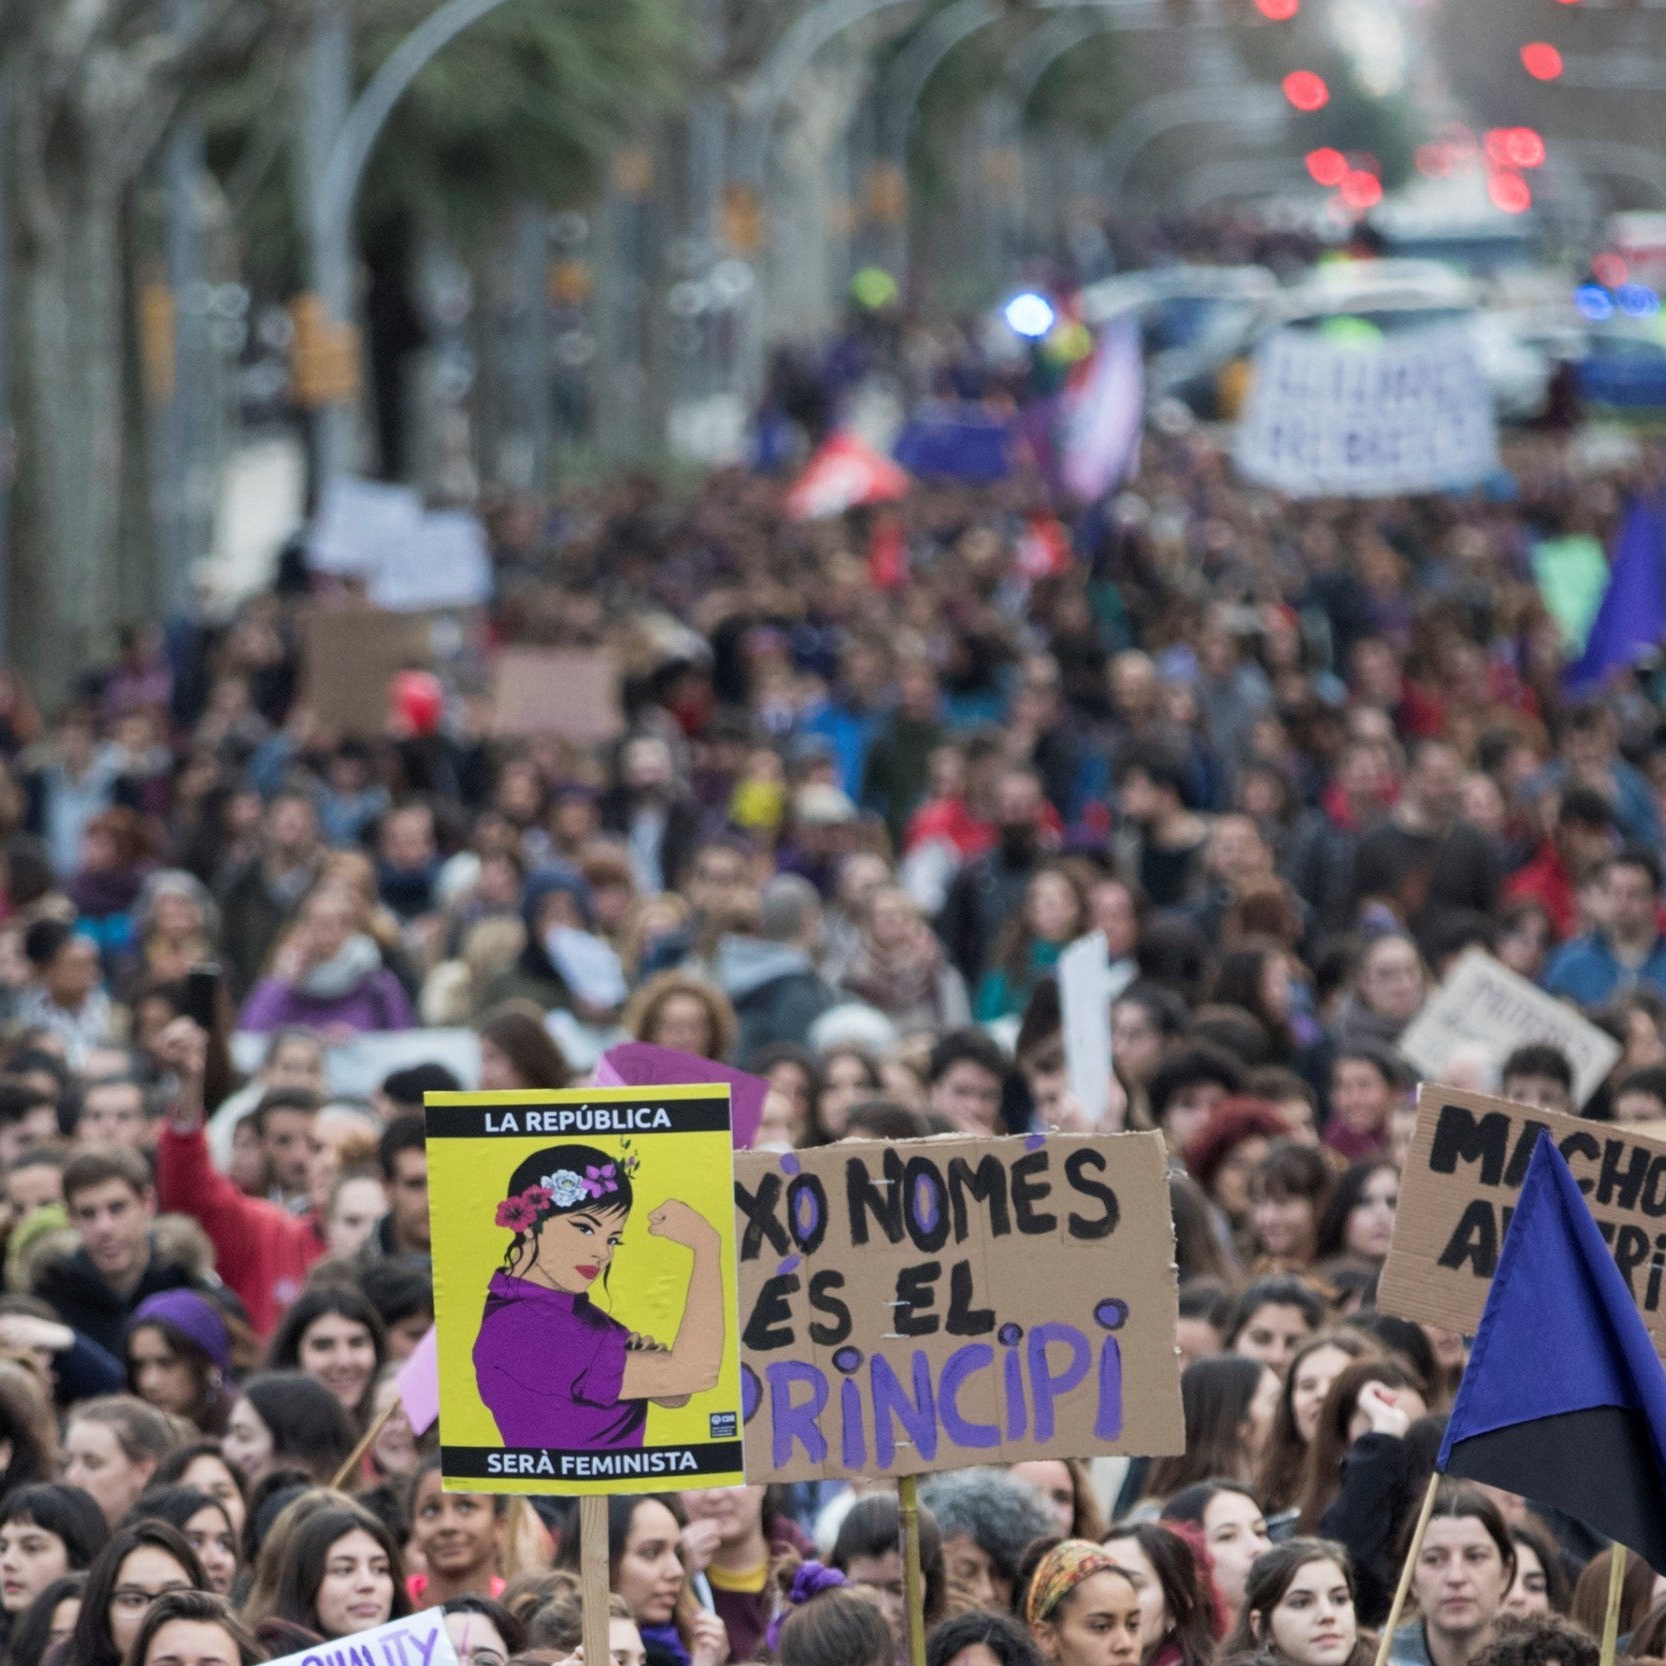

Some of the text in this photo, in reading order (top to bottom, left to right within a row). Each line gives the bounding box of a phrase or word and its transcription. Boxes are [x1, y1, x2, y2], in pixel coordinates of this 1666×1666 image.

[484, 1101, 672, 1133] LA REPÚBLICA
[846, 1135, 1120, 1253] NOMÉS
[742, 1254, 996, 1352] ÉS EL
[487, 1448, 697, 1475] SERÀ FEMINISTA
